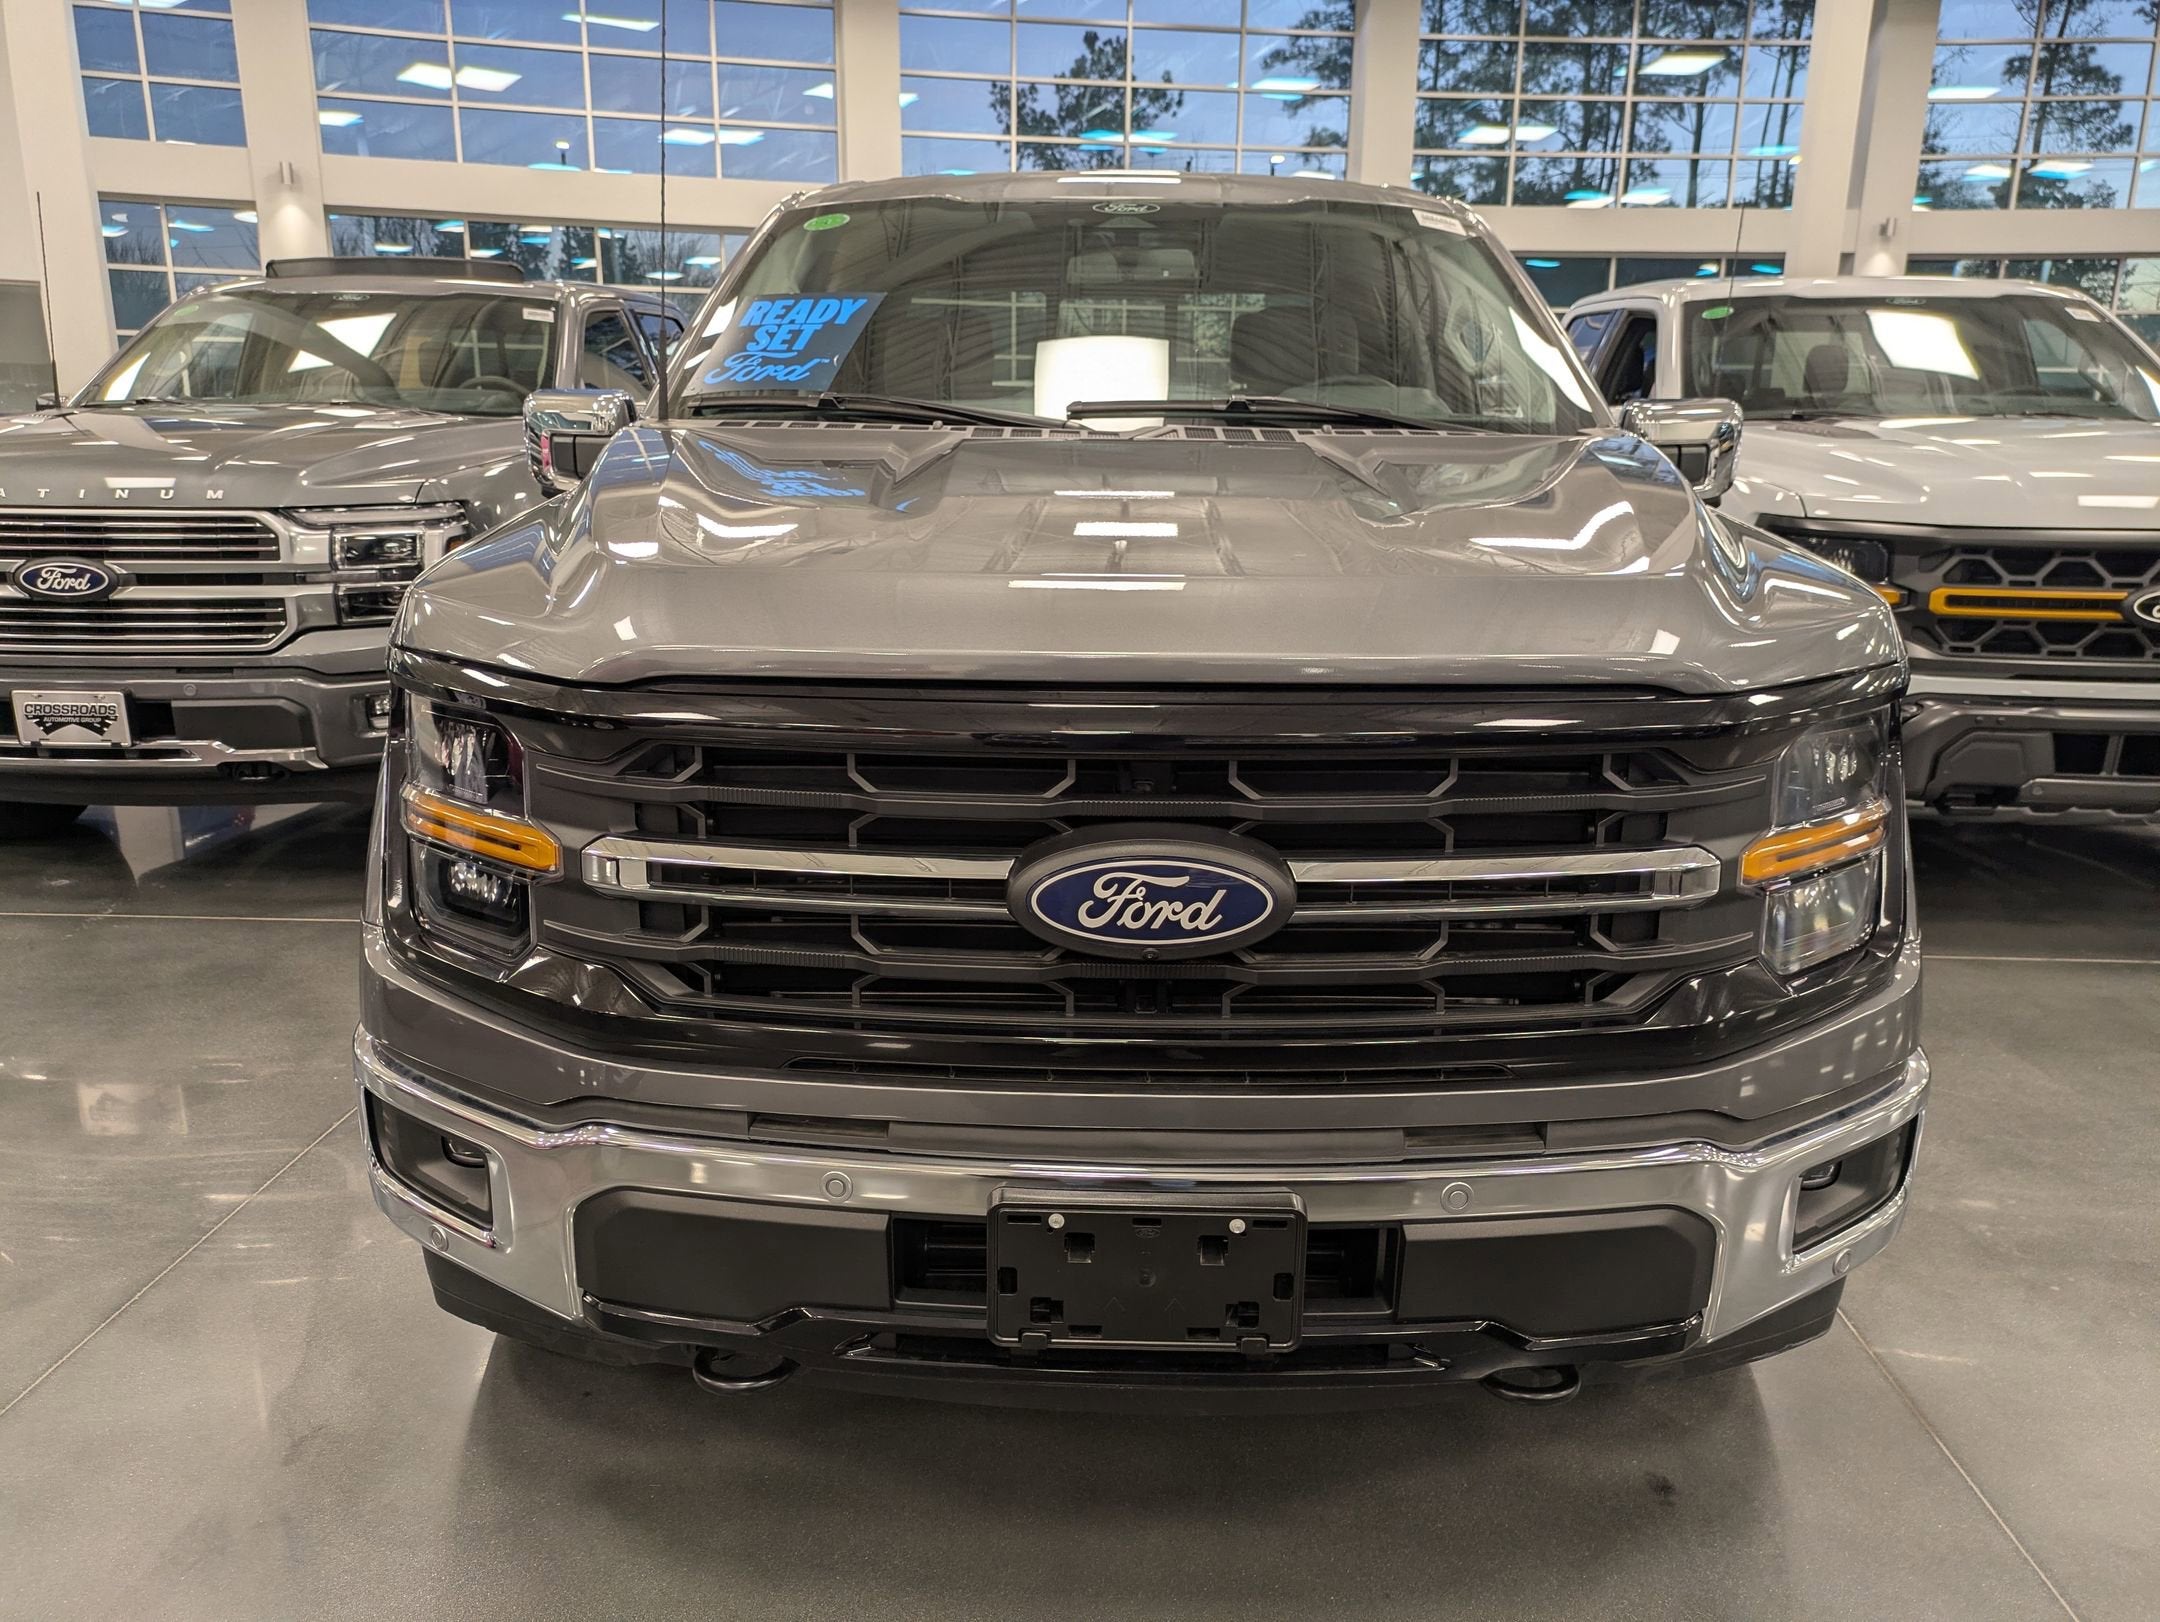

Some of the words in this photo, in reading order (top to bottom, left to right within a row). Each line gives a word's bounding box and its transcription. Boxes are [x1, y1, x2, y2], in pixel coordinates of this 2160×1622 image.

[739, 298, 868, 327] READY
[746, 323, 824, 351] SET
[36, 567, 91, 591] Ford
[24, 703, 117, 715] CROSSROADS
[1077, 871, 1228, 931] Ford
